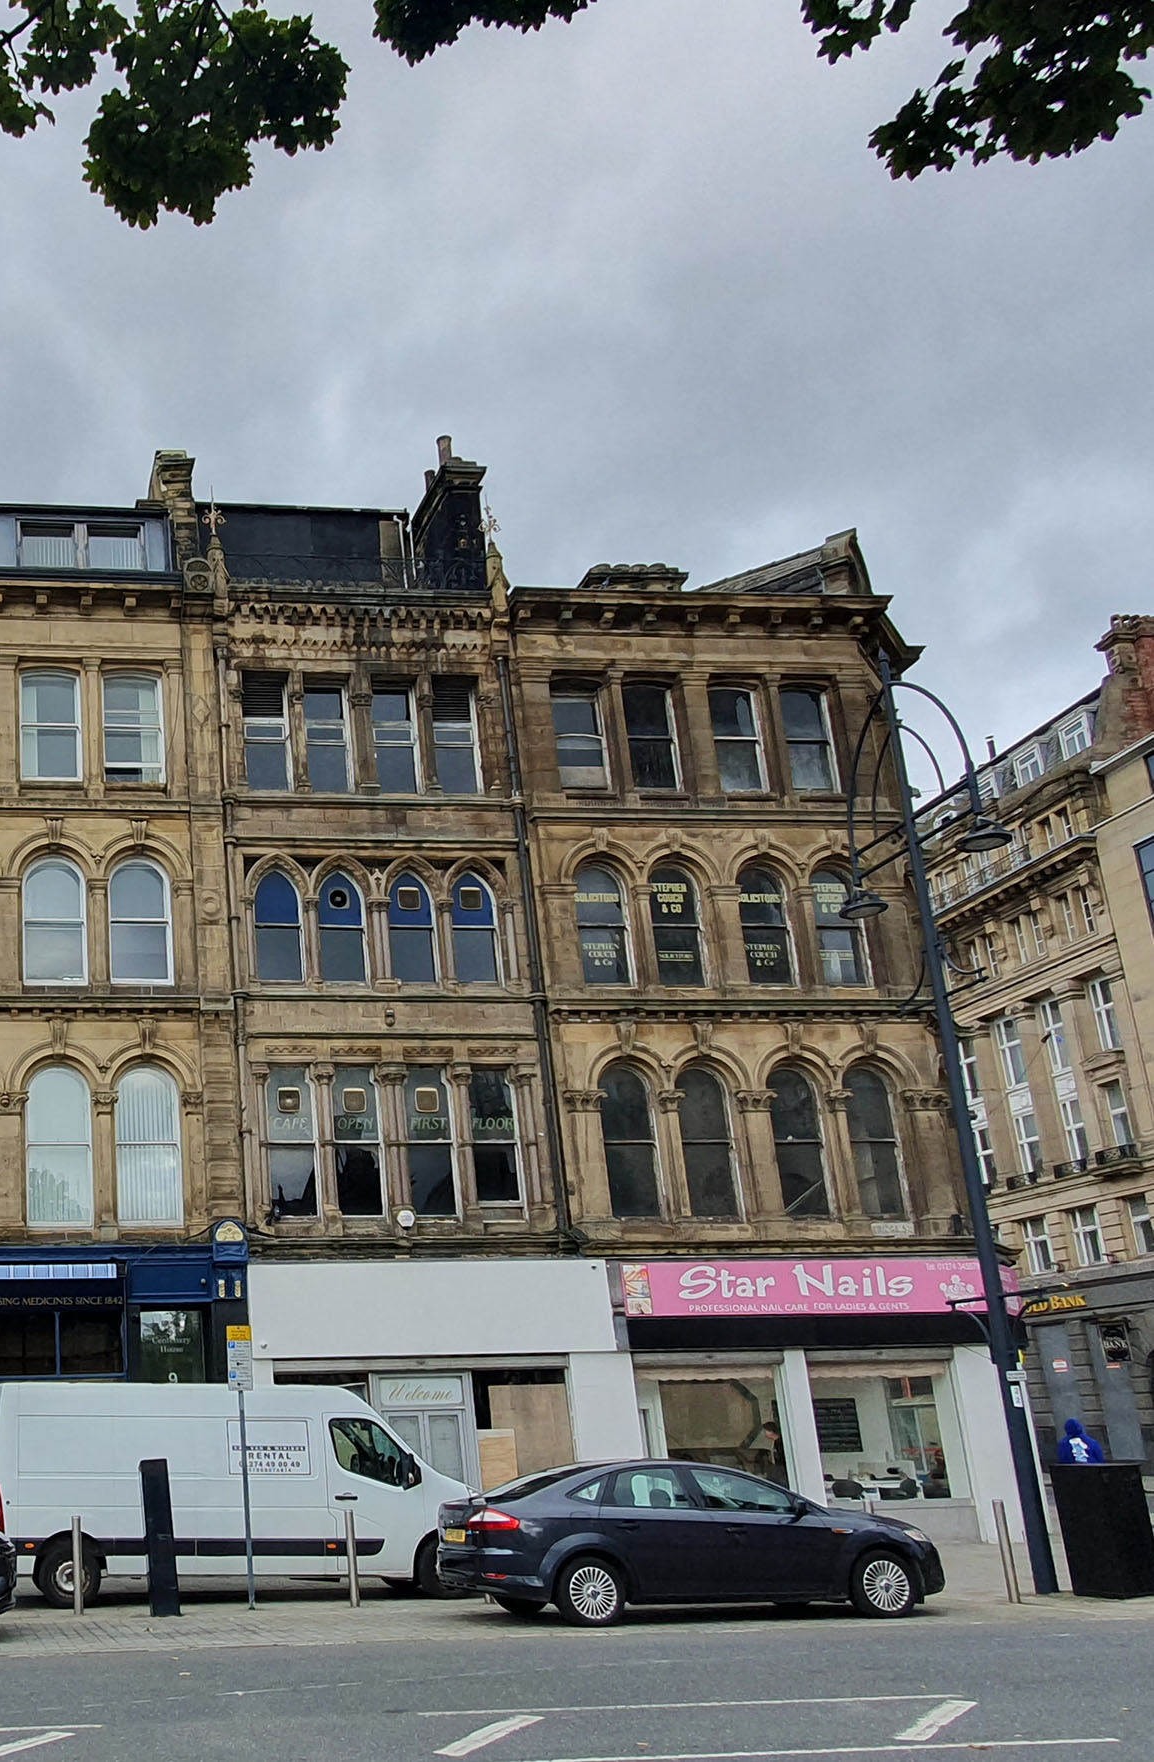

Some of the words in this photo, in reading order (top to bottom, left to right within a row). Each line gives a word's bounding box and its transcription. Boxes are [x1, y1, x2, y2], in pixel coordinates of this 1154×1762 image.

[337, 1117, 373, 1130] OPEN
[411, 1117, 448, 1130] FIRST
[472, 1117, 514, 1130] FLOOR
[678, 1265, 775, 1300] Star
[792, 1264, 914, 1298] Nails
[22, 1296, 73, 1306] MEDICINES
[75, 1296, 103, 1305] SINCE
[104, 1296, 123, 1305] 1842
[688, 1303, 760, 1313] PROFESSIONAL
[761, 1303, 782, 1312] NAIL
[784, 1303, 809, 1312] CARE
[813, 1302, 833, 1311] FOR
[834, 1302, 866, 1311] LADIES
[868, 1302, 877, 1311] &
[878, 1302, 910, 1311] GENTS
[1050, 1295, 1087, 1311] BANK
[168, 1371, 178, 1383] 9
[389, 1383, 453, 1401] Welcome
